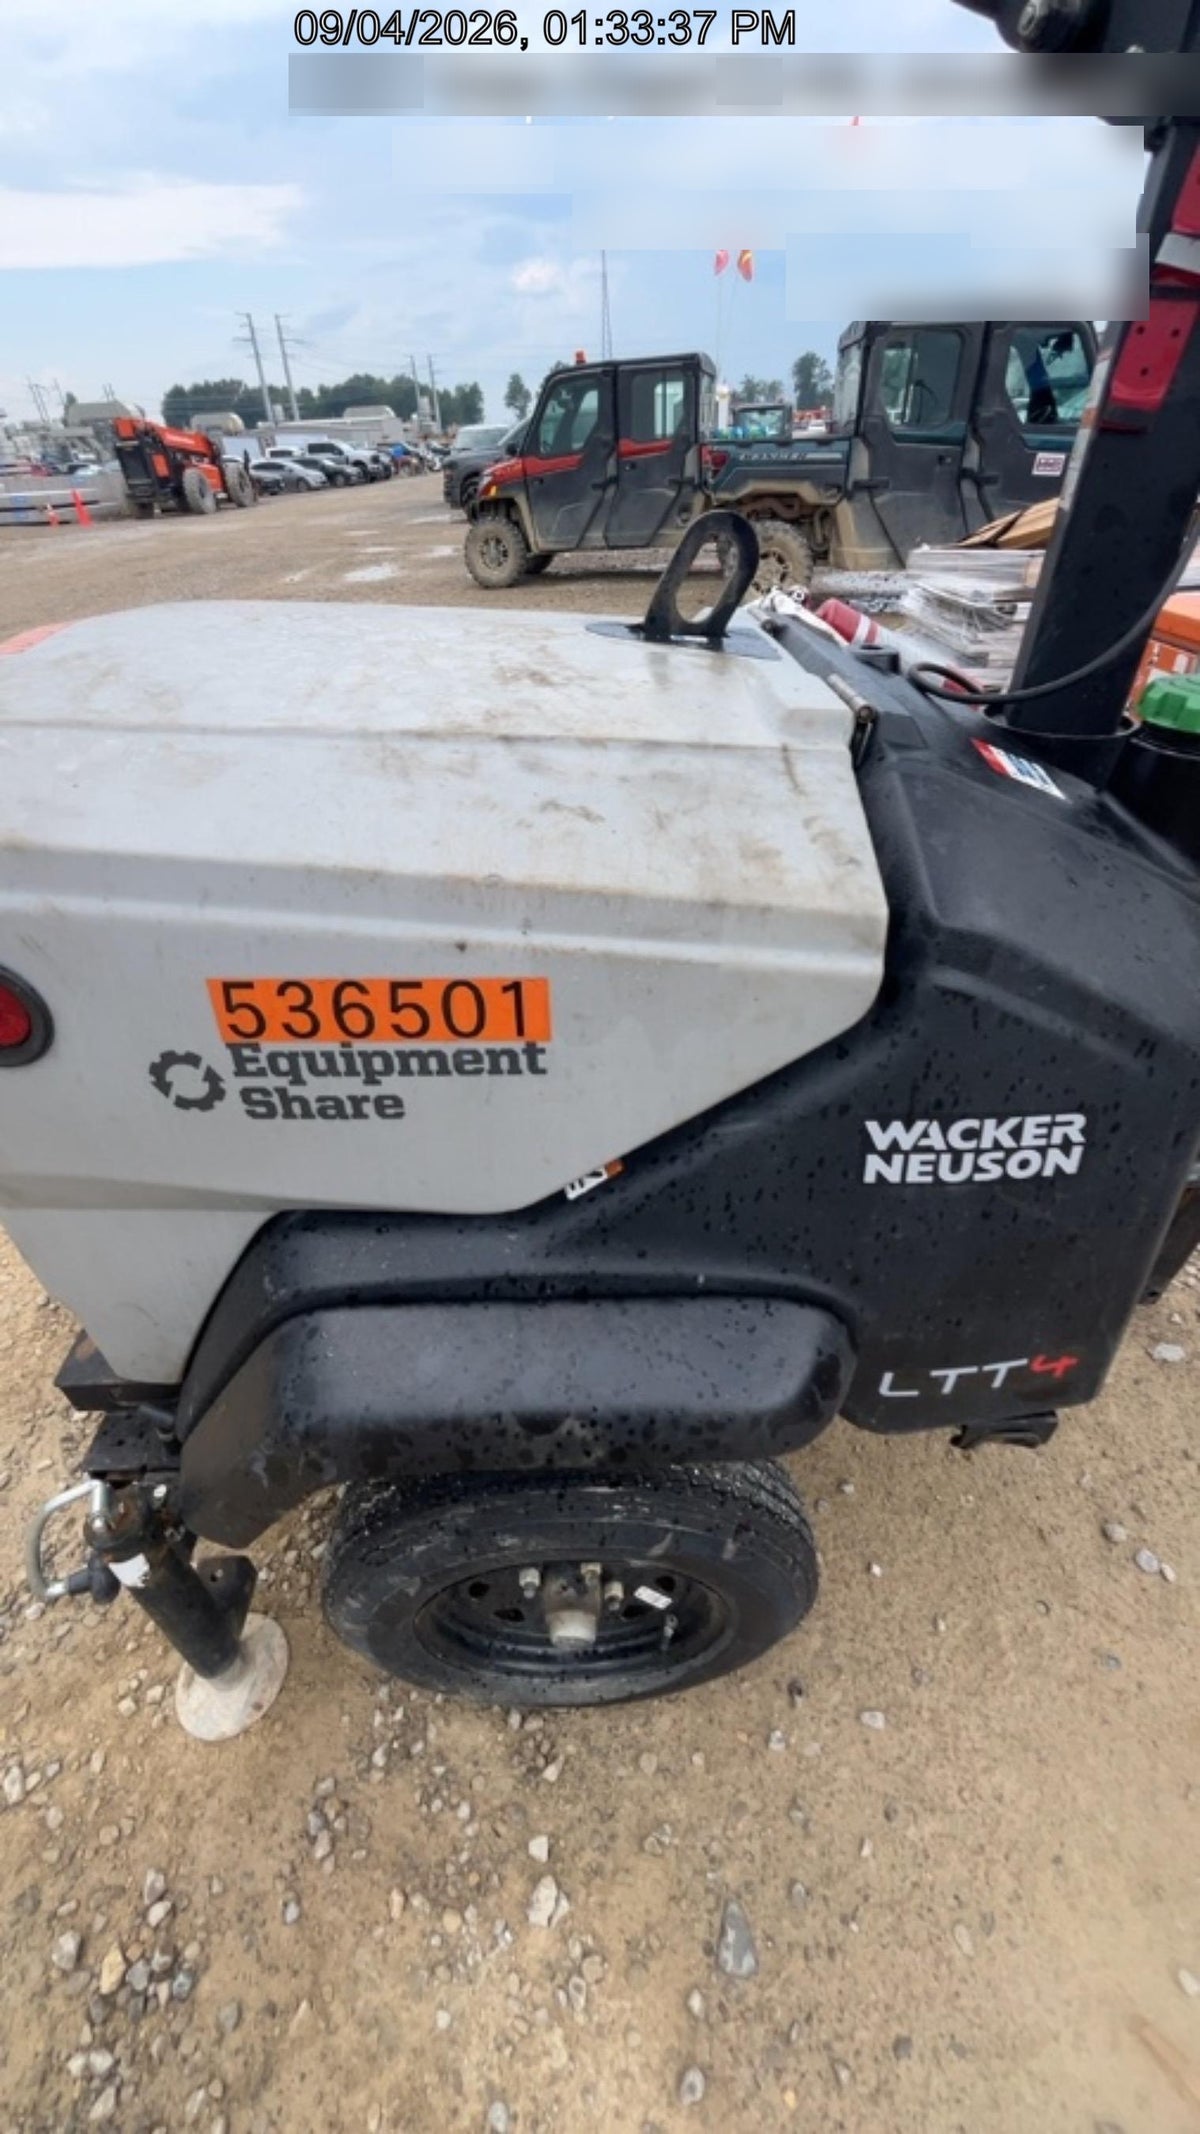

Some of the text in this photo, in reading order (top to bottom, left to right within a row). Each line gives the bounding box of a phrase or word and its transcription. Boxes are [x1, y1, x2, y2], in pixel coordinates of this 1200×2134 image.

[221, 980, 527, 1040] 536501
[227, 1041, 547, 1085] Equipment
[239, 1087, 404, 1120] Share
[865, 1114, 1087, 1151] WACKER
[863, 1145, 1084, 1184] NEUSON
